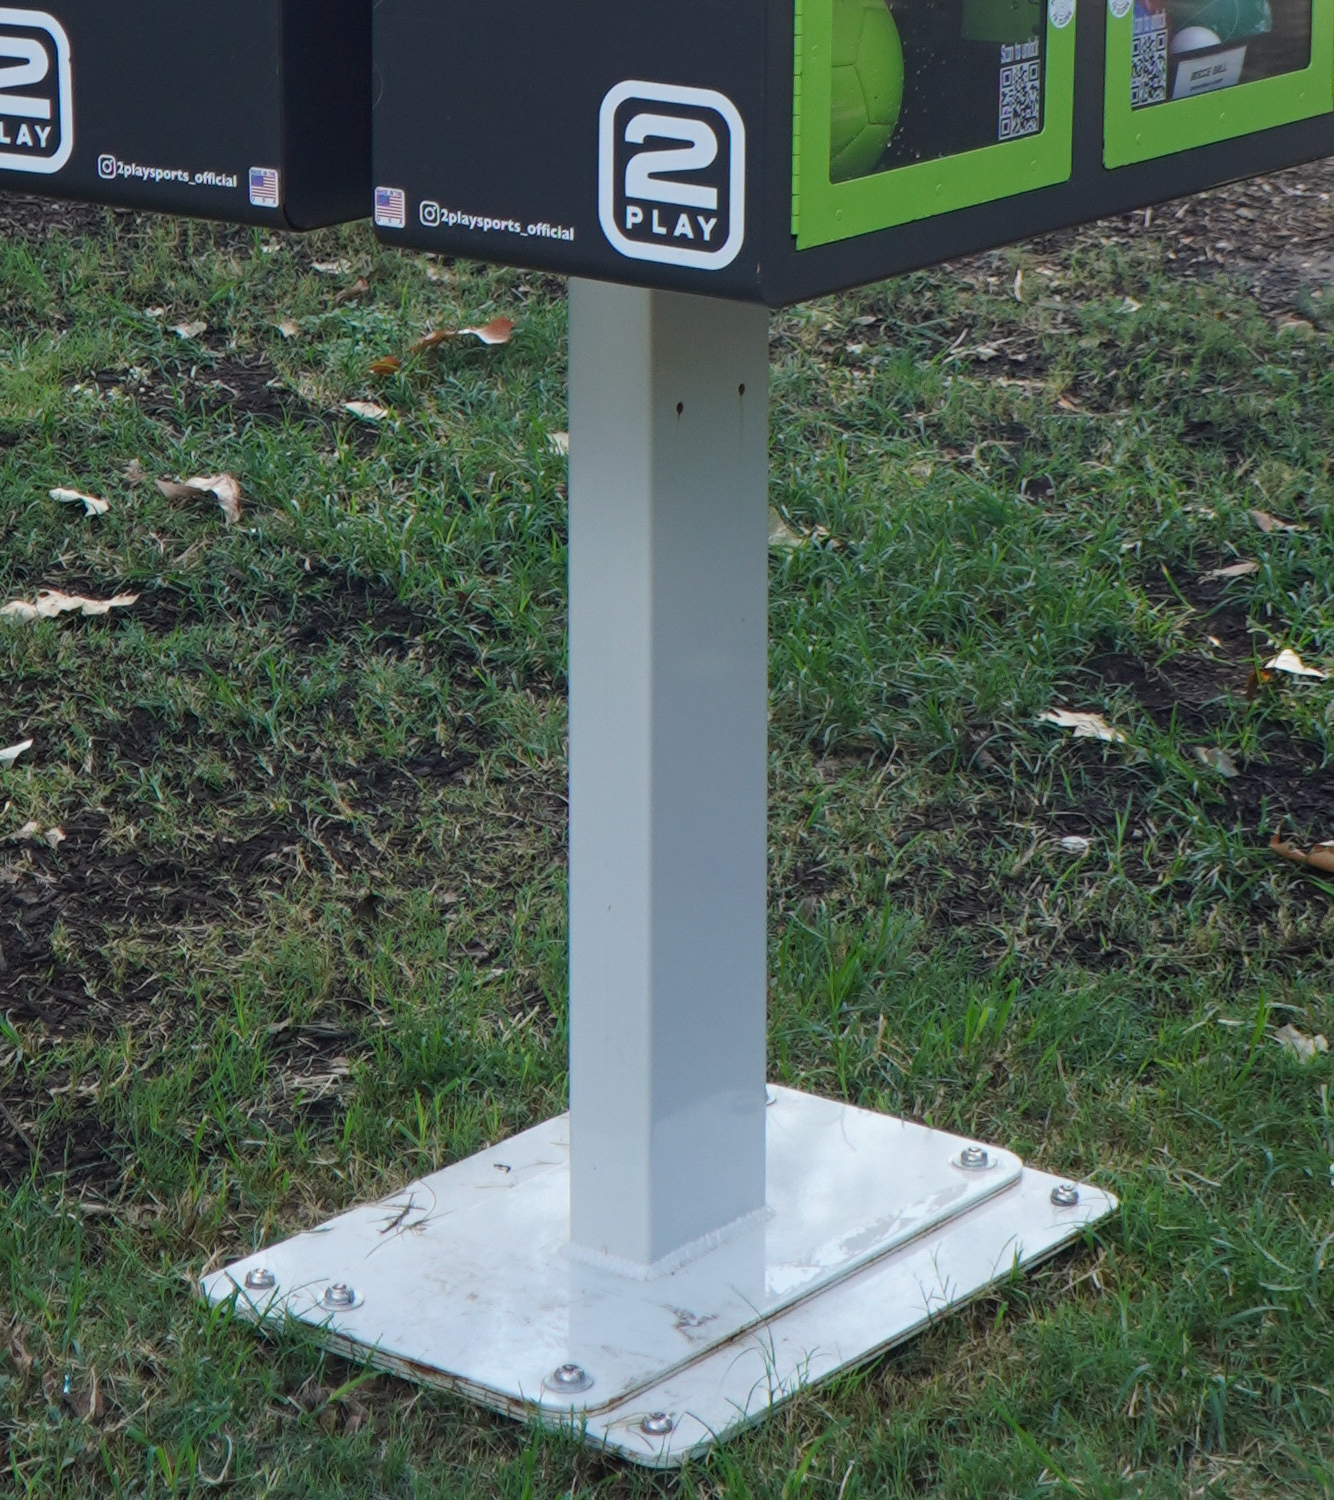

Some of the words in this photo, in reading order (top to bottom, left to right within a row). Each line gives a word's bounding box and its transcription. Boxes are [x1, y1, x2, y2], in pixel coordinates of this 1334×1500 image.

[116, 161, 238, 188] 2playsports_official
[624, 112, 719, 210] 2
[440, 208, 575, 242] 2playsports_official
[626, 205, 718, 241] PLAY
